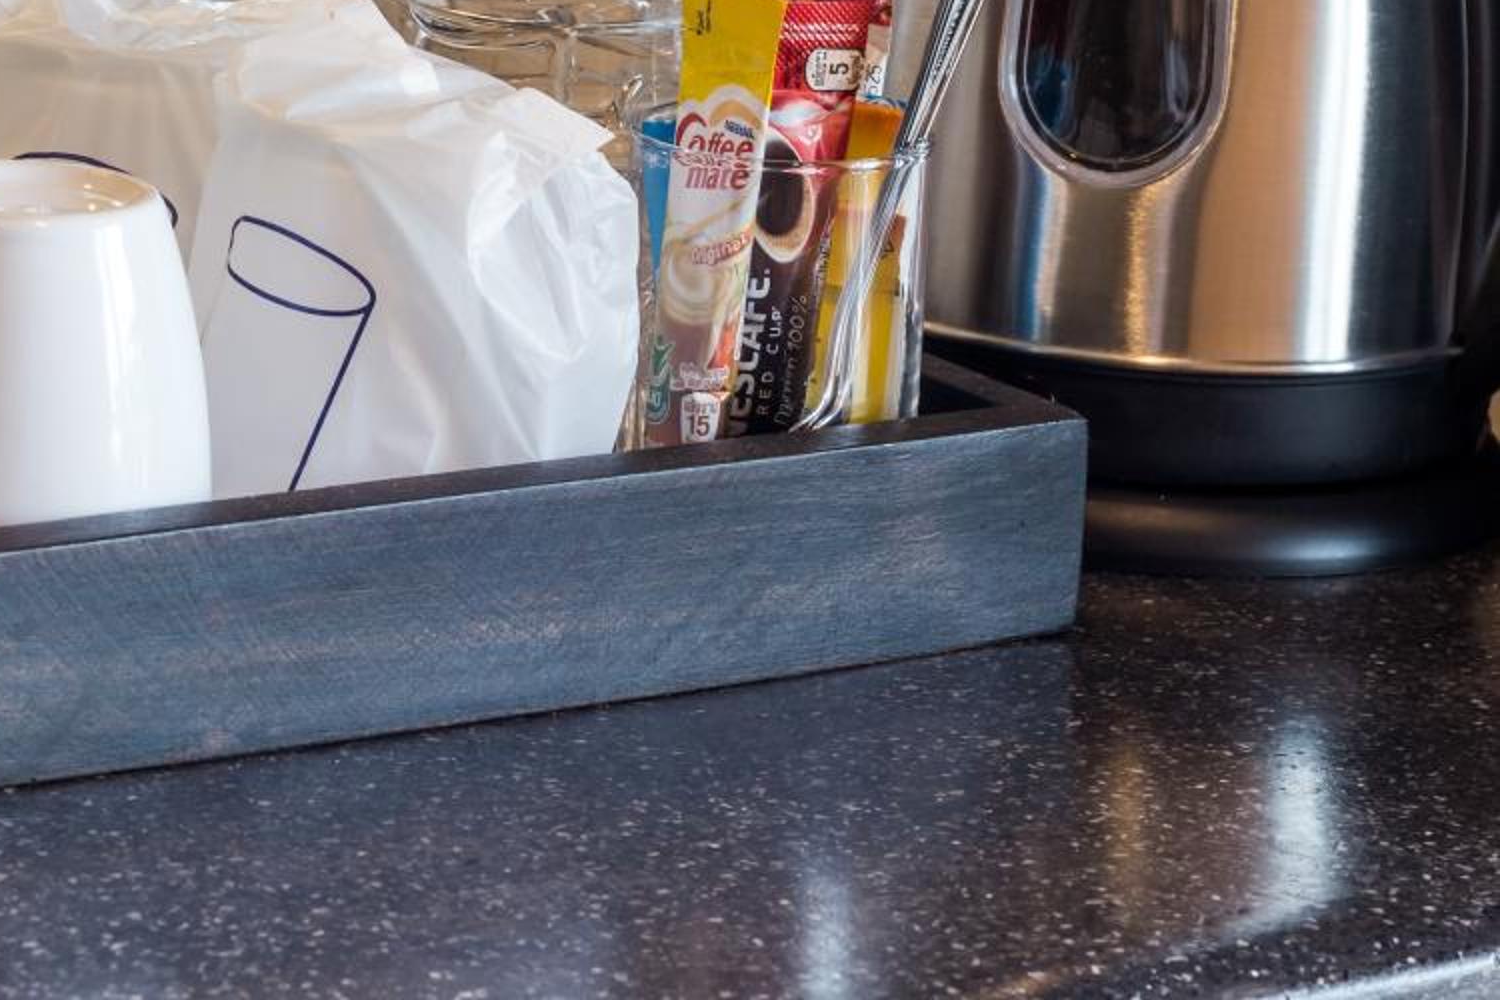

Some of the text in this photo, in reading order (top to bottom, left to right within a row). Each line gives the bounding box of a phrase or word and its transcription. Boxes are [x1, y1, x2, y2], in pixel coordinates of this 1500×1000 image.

[829, 62, 849, 76] 5
[756, 370, 776, 416] RED
[687, 415, 711, 437] 15
